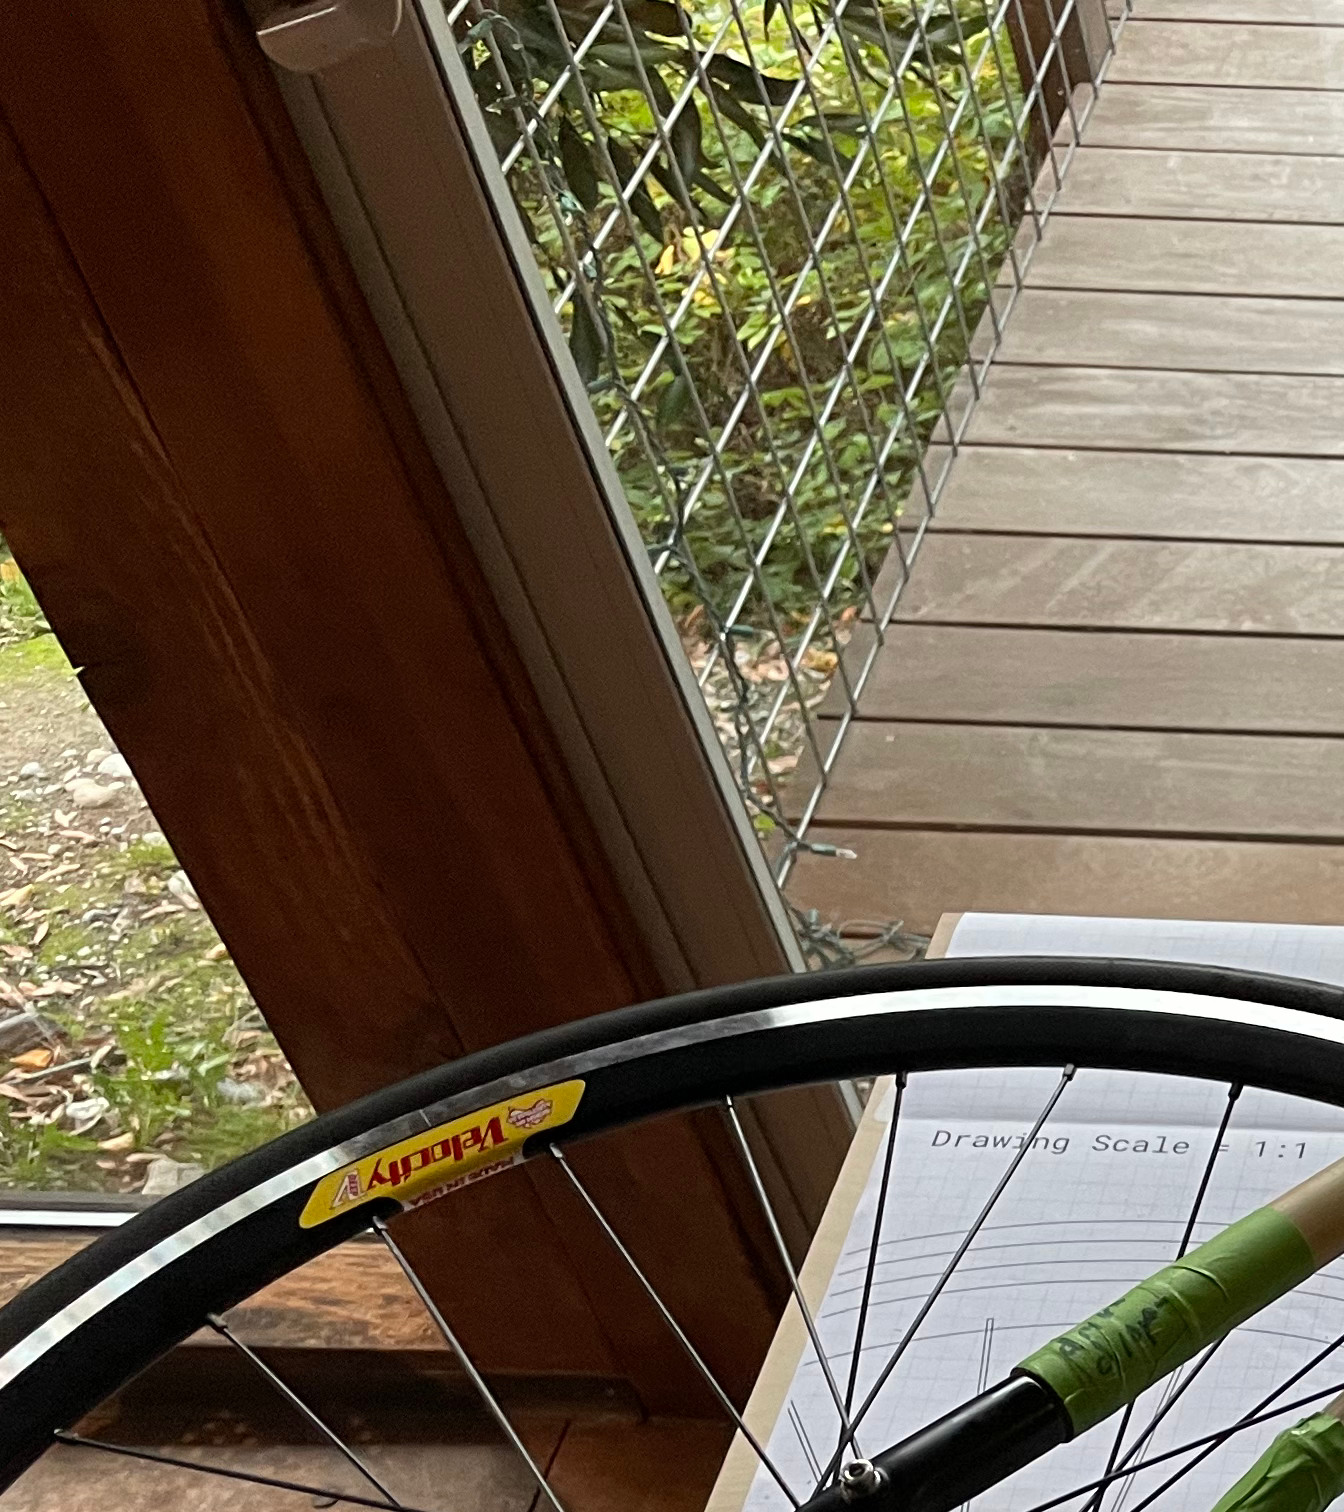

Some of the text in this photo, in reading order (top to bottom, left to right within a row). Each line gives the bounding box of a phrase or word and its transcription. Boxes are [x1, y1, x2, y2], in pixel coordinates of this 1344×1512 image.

[367, 1116, 509, 1193] Velocity
[931, 1129, 1070, 1155] Drawing
[1092, 1131, 1190, 1155] Scale
[1255, 1141, 1308, 1160] 1:1
